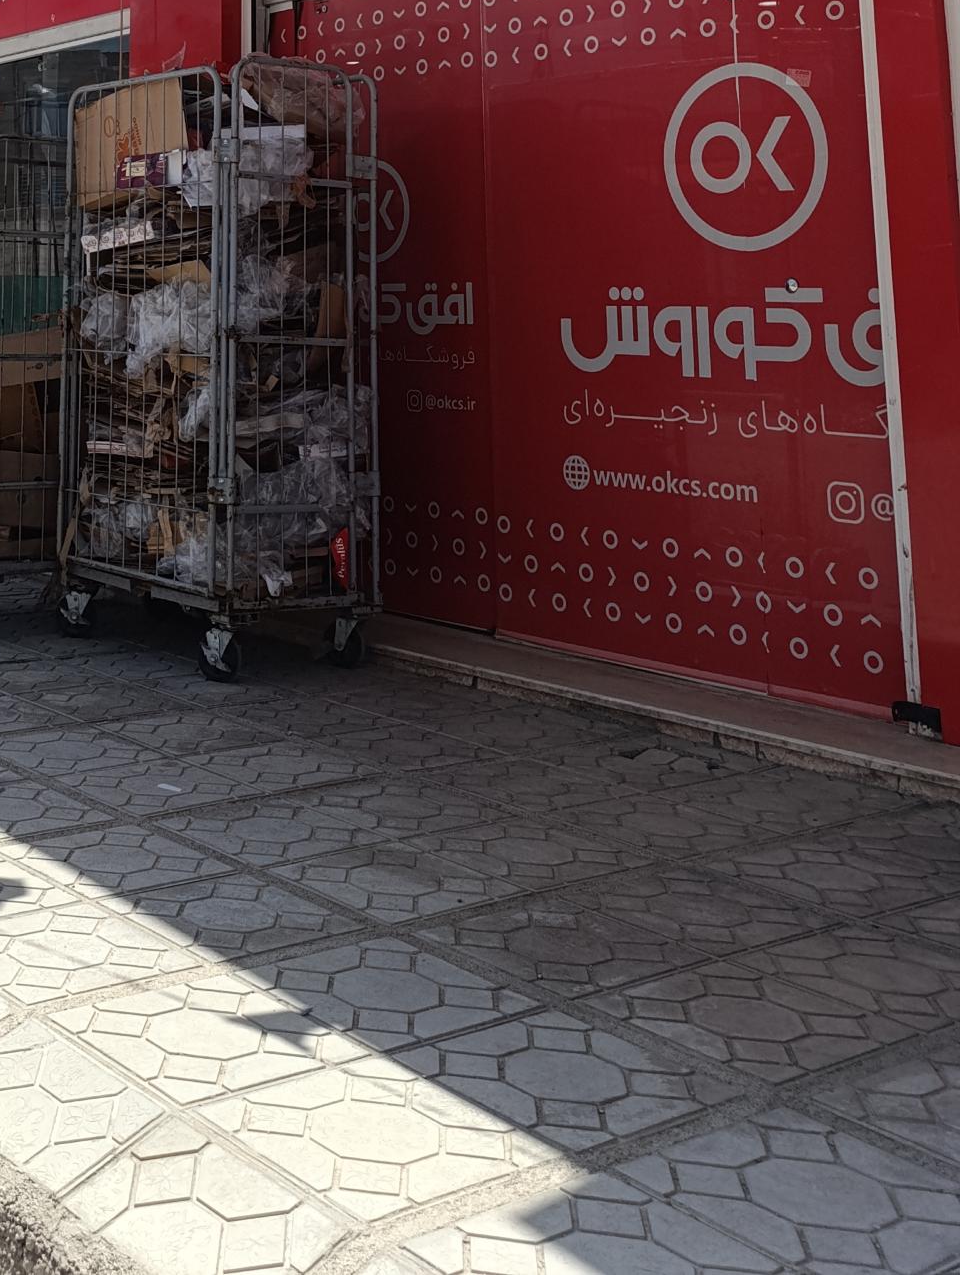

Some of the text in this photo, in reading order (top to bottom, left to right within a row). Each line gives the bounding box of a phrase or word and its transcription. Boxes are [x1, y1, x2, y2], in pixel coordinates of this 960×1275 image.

[690, 116, 795, 193] OK
[406, 281, 475, 335] افق
[560, 286, 824, 381] کوروش
[379, 345, 476, 371] فروشگاه‌ها
[425, 395, 476, 412] @okcs.ir
[593, 469, 759, 503] www.okcs.com
